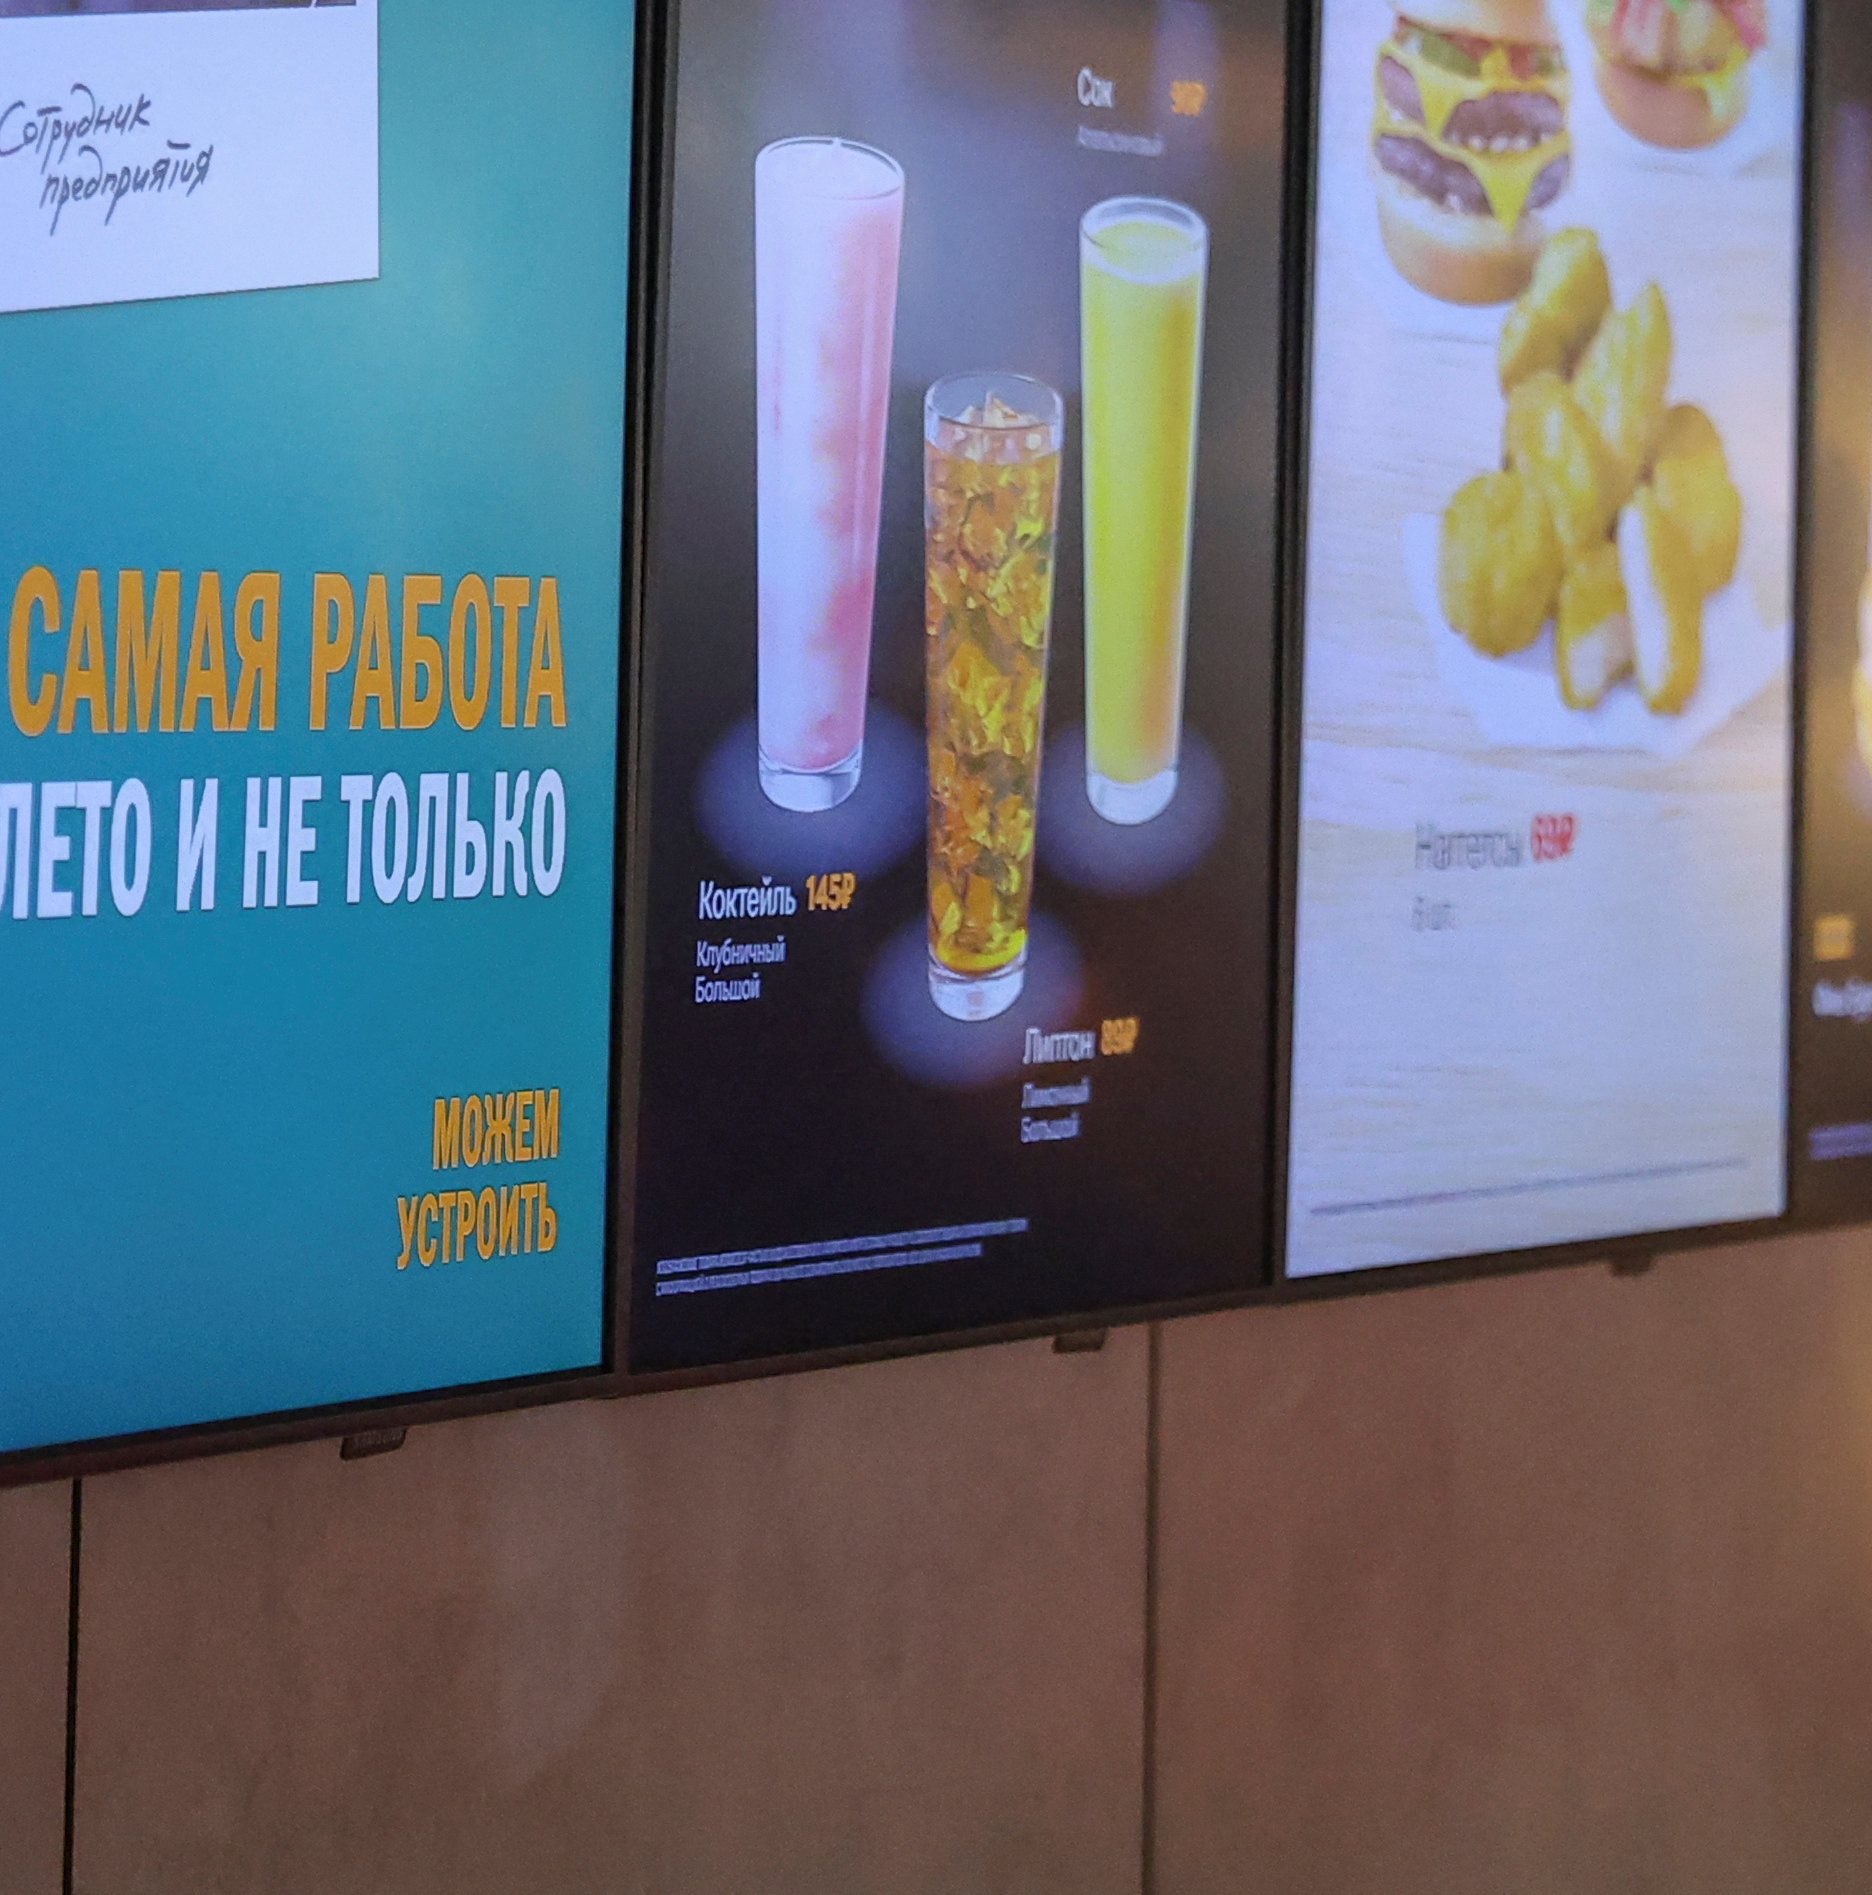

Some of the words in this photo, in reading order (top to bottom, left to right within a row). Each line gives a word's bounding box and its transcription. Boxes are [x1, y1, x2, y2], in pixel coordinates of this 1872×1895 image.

[40, 140, 214, 235] предприятия
[8, 565, 281, 737] САМАЯ
[308, 572, 568, 732] РАБОТА
[176, 777, 219, 912] И
[242, 775, 323, 909] НЕ
[341, 768, 567, 905] ТОЛЬКО
[698, 876, 796, 920] Коктейль
[695, 972, 763, 1004] Большой
[696, 935, 787, 968] Клубничный
[1023, 1027, 1096, 1065] Липтон
[432, 1088, 561, 1171] МОЖЕМ
[396, 1181, 559, 1270] УСТРОИТЬ
